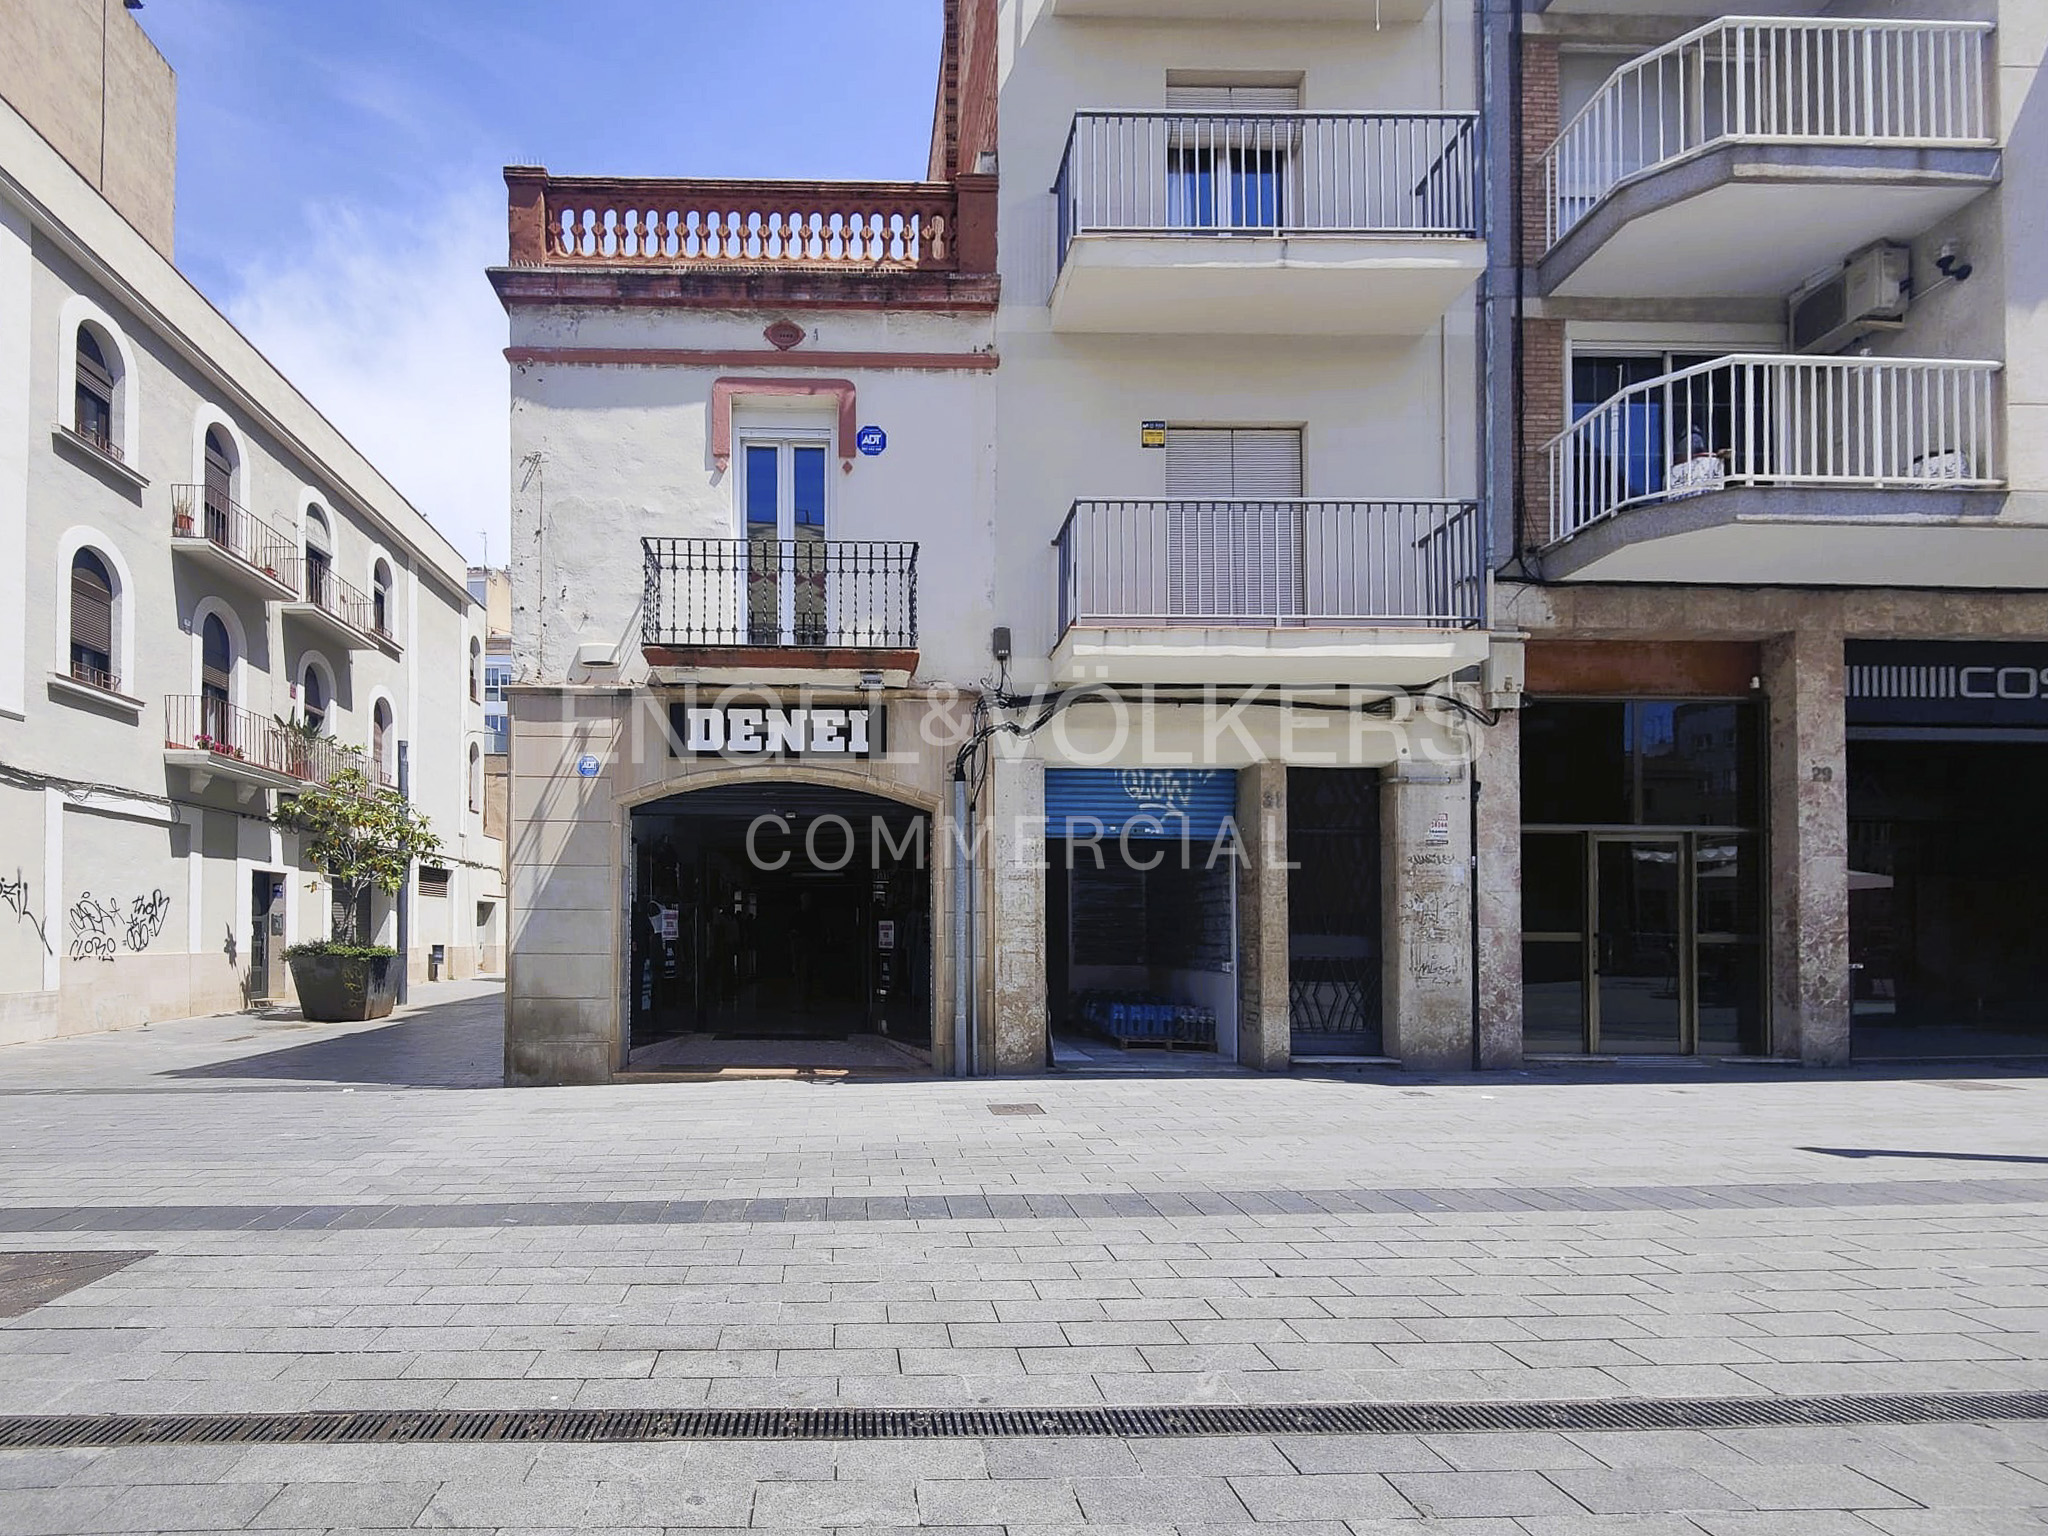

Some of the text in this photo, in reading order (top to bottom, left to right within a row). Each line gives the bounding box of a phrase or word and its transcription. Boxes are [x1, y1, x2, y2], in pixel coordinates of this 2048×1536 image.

[862, 434, 882, 445] ADT
[1960, 666, 2048, 699] CO
[687, 708, 869, 752] DENEI
